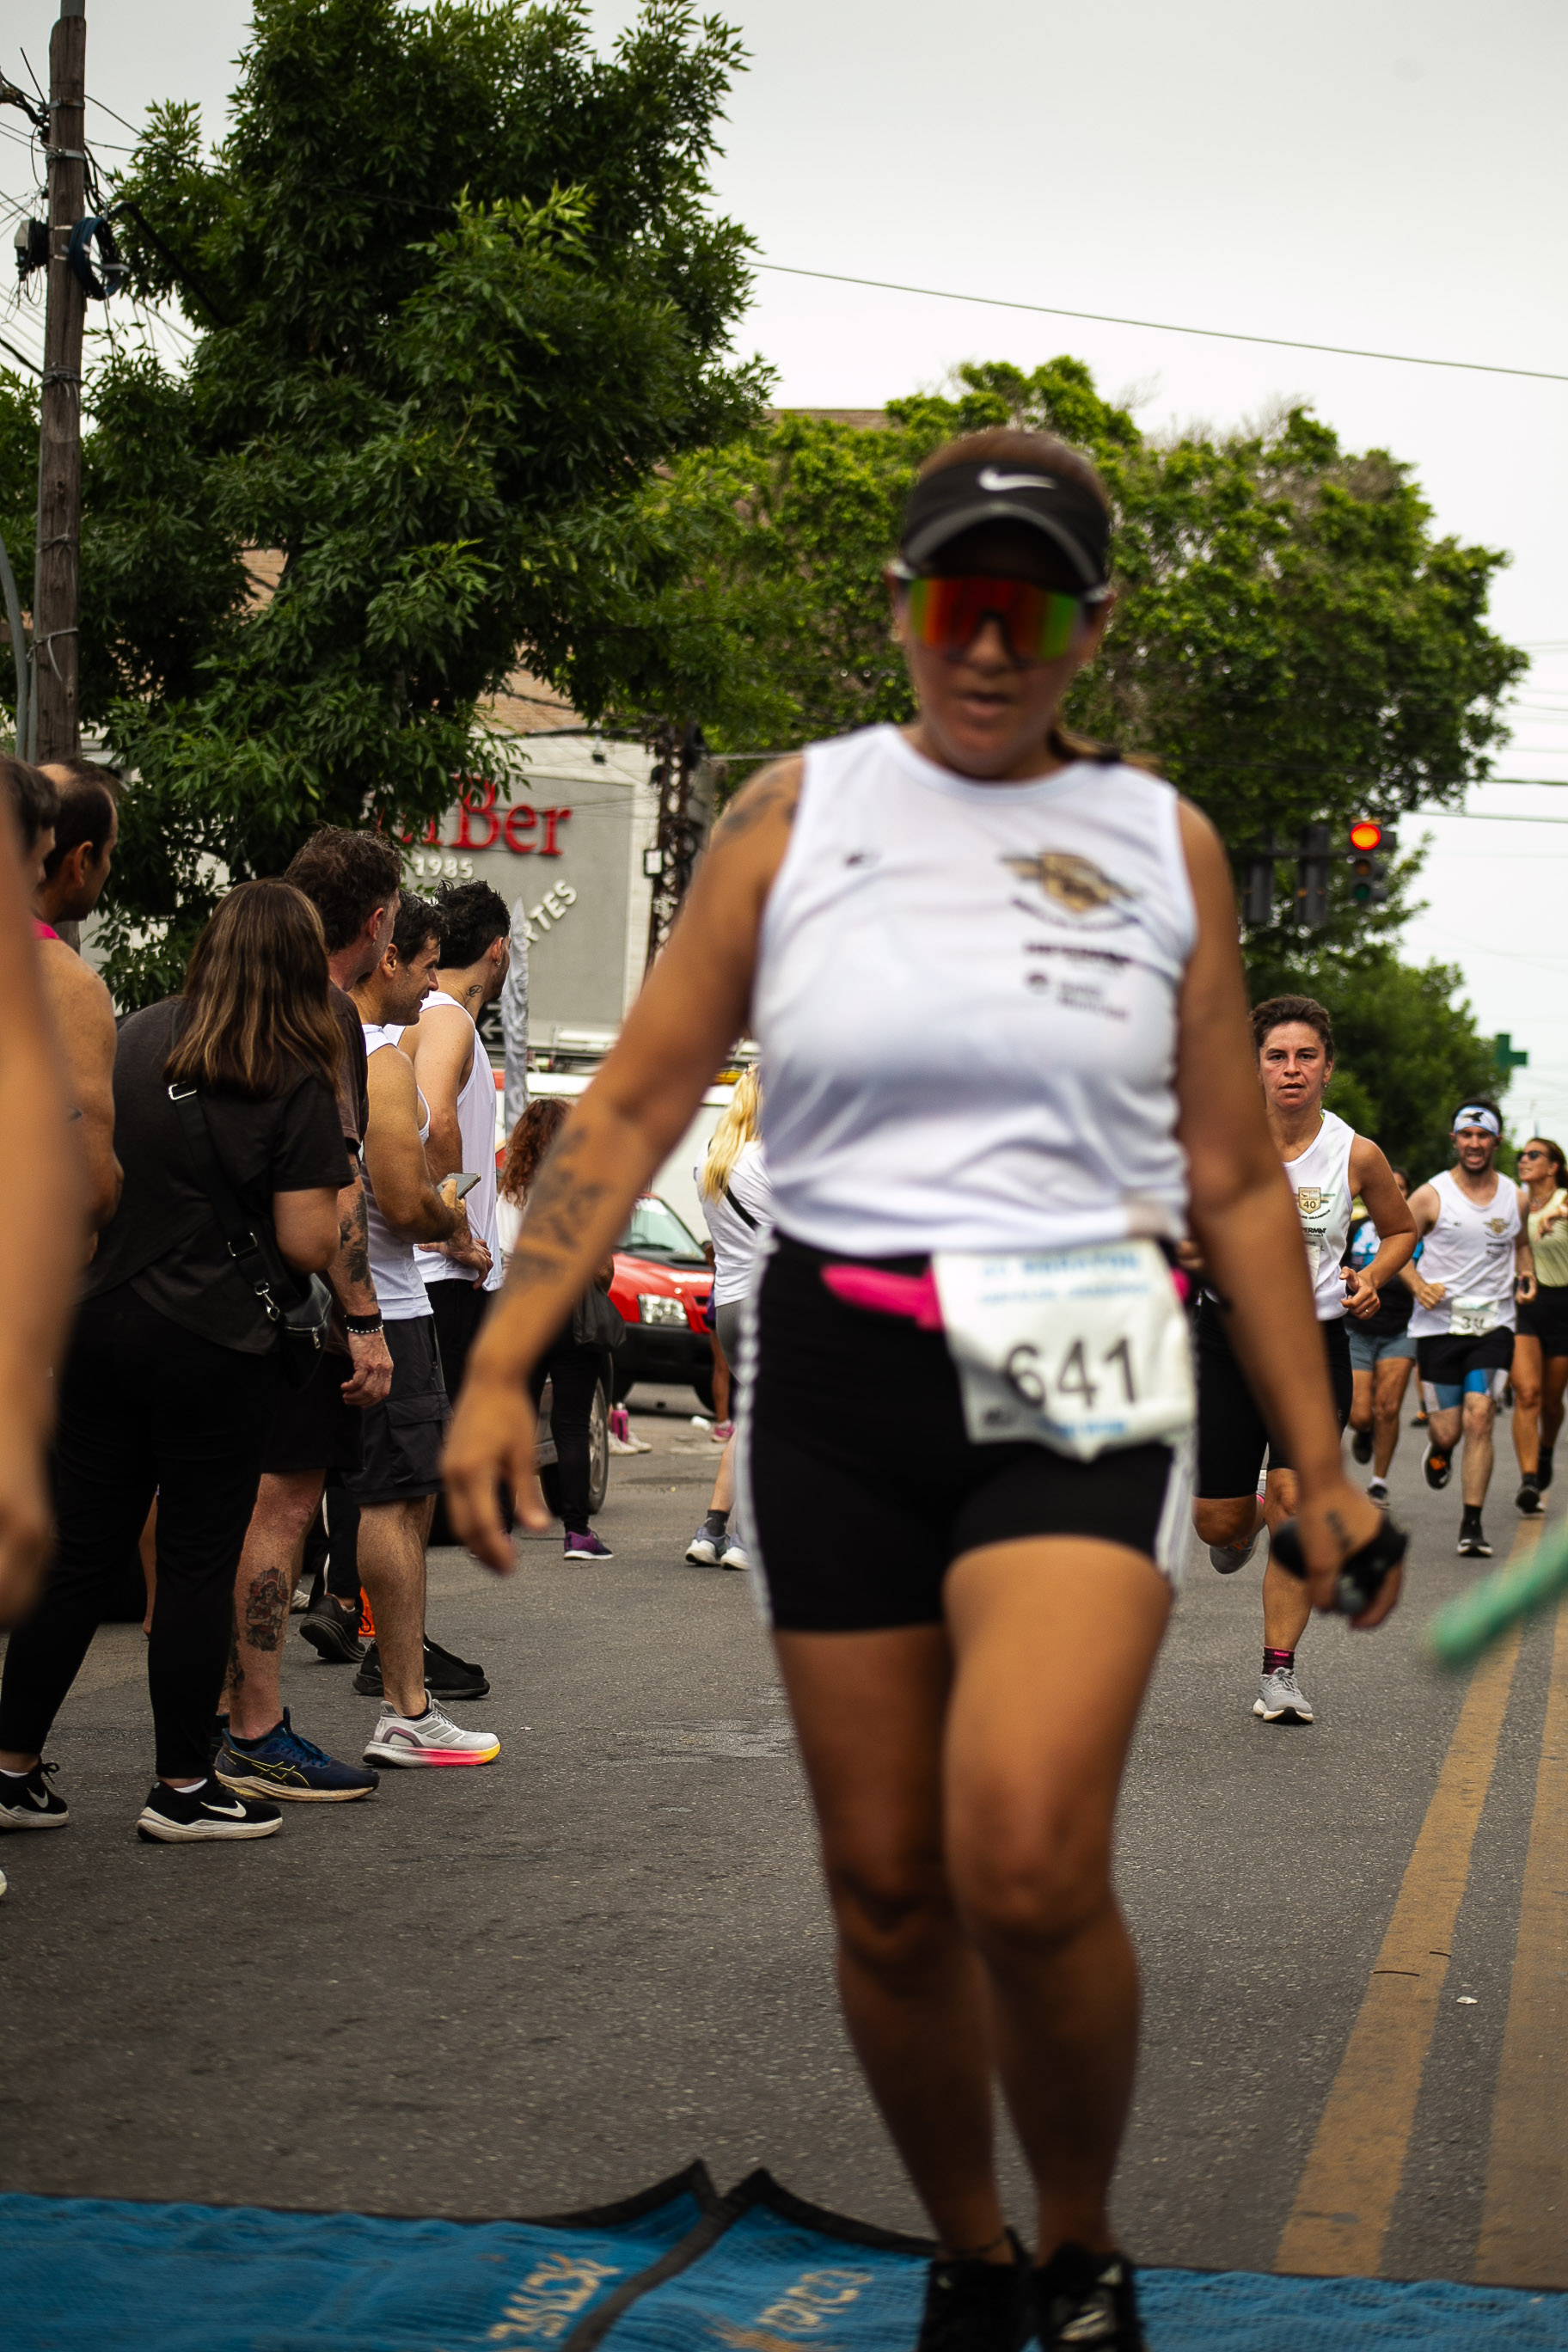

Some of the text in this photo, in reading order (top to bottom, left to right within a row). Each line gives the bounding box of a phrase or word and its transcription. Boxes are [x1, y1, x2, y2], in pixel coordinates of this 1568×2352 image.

[451, 773, 573, 856] Ber
[413, 855, 474, 879] 1985
[1303, 1200, 1316, 1209] 40
[1003, 1337, 1136, 1411] 641
